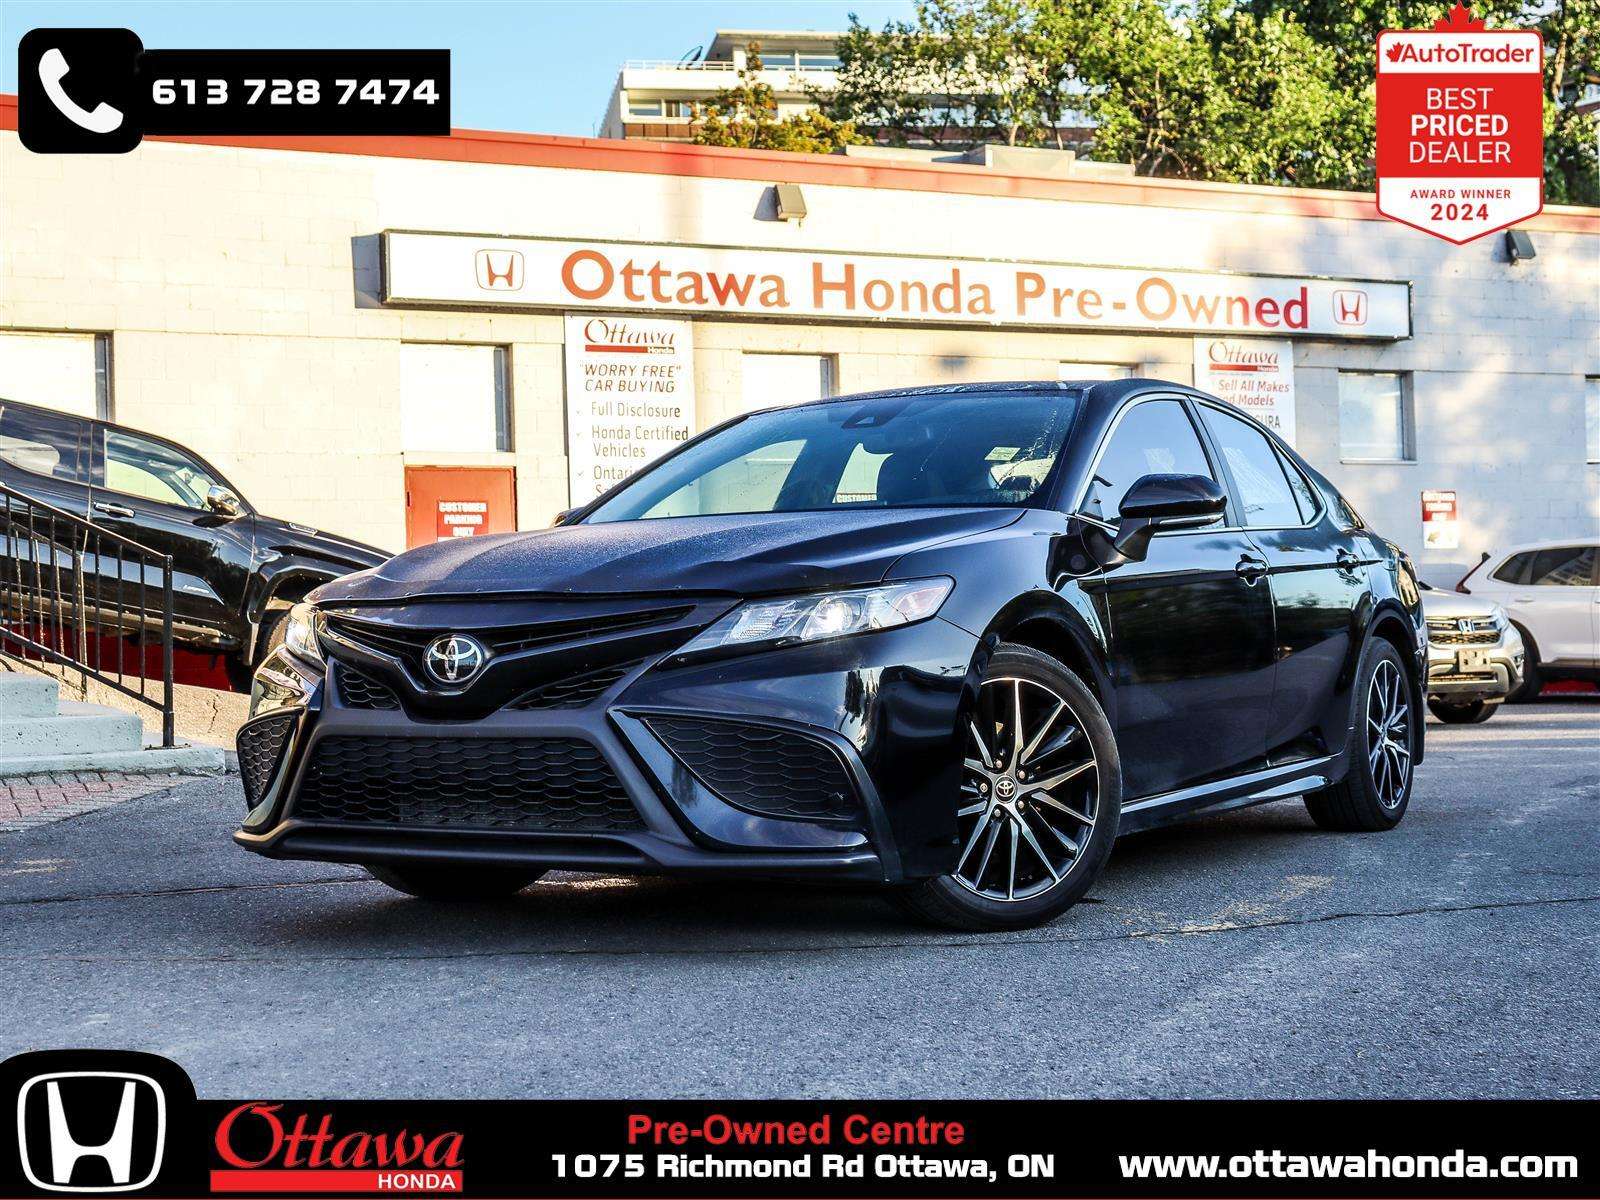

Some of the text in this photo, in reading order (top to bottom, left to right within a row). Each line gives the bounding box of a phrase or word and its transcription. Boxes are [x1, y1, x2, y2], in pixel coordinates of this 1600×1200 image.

[561, 249, 790, 308] Ottawa
[812, 262, 995, 315] Honda
[584, 318, 675, 345] Ottawa
[1209, 341, 1279, 364] Ottawa
[585, 379, 675, 393] CAR BUYING
[1218, 379, 1290, 393] Sell All Makes
[1238, 393, 1274, 406] Models
[592, 401, 681, 418] Full Disclosure
[592, 425, 689, 441] Honda Certified
[593, 444, 646, 458] Vehicles
[594, 465, 634, 480] Ontari
